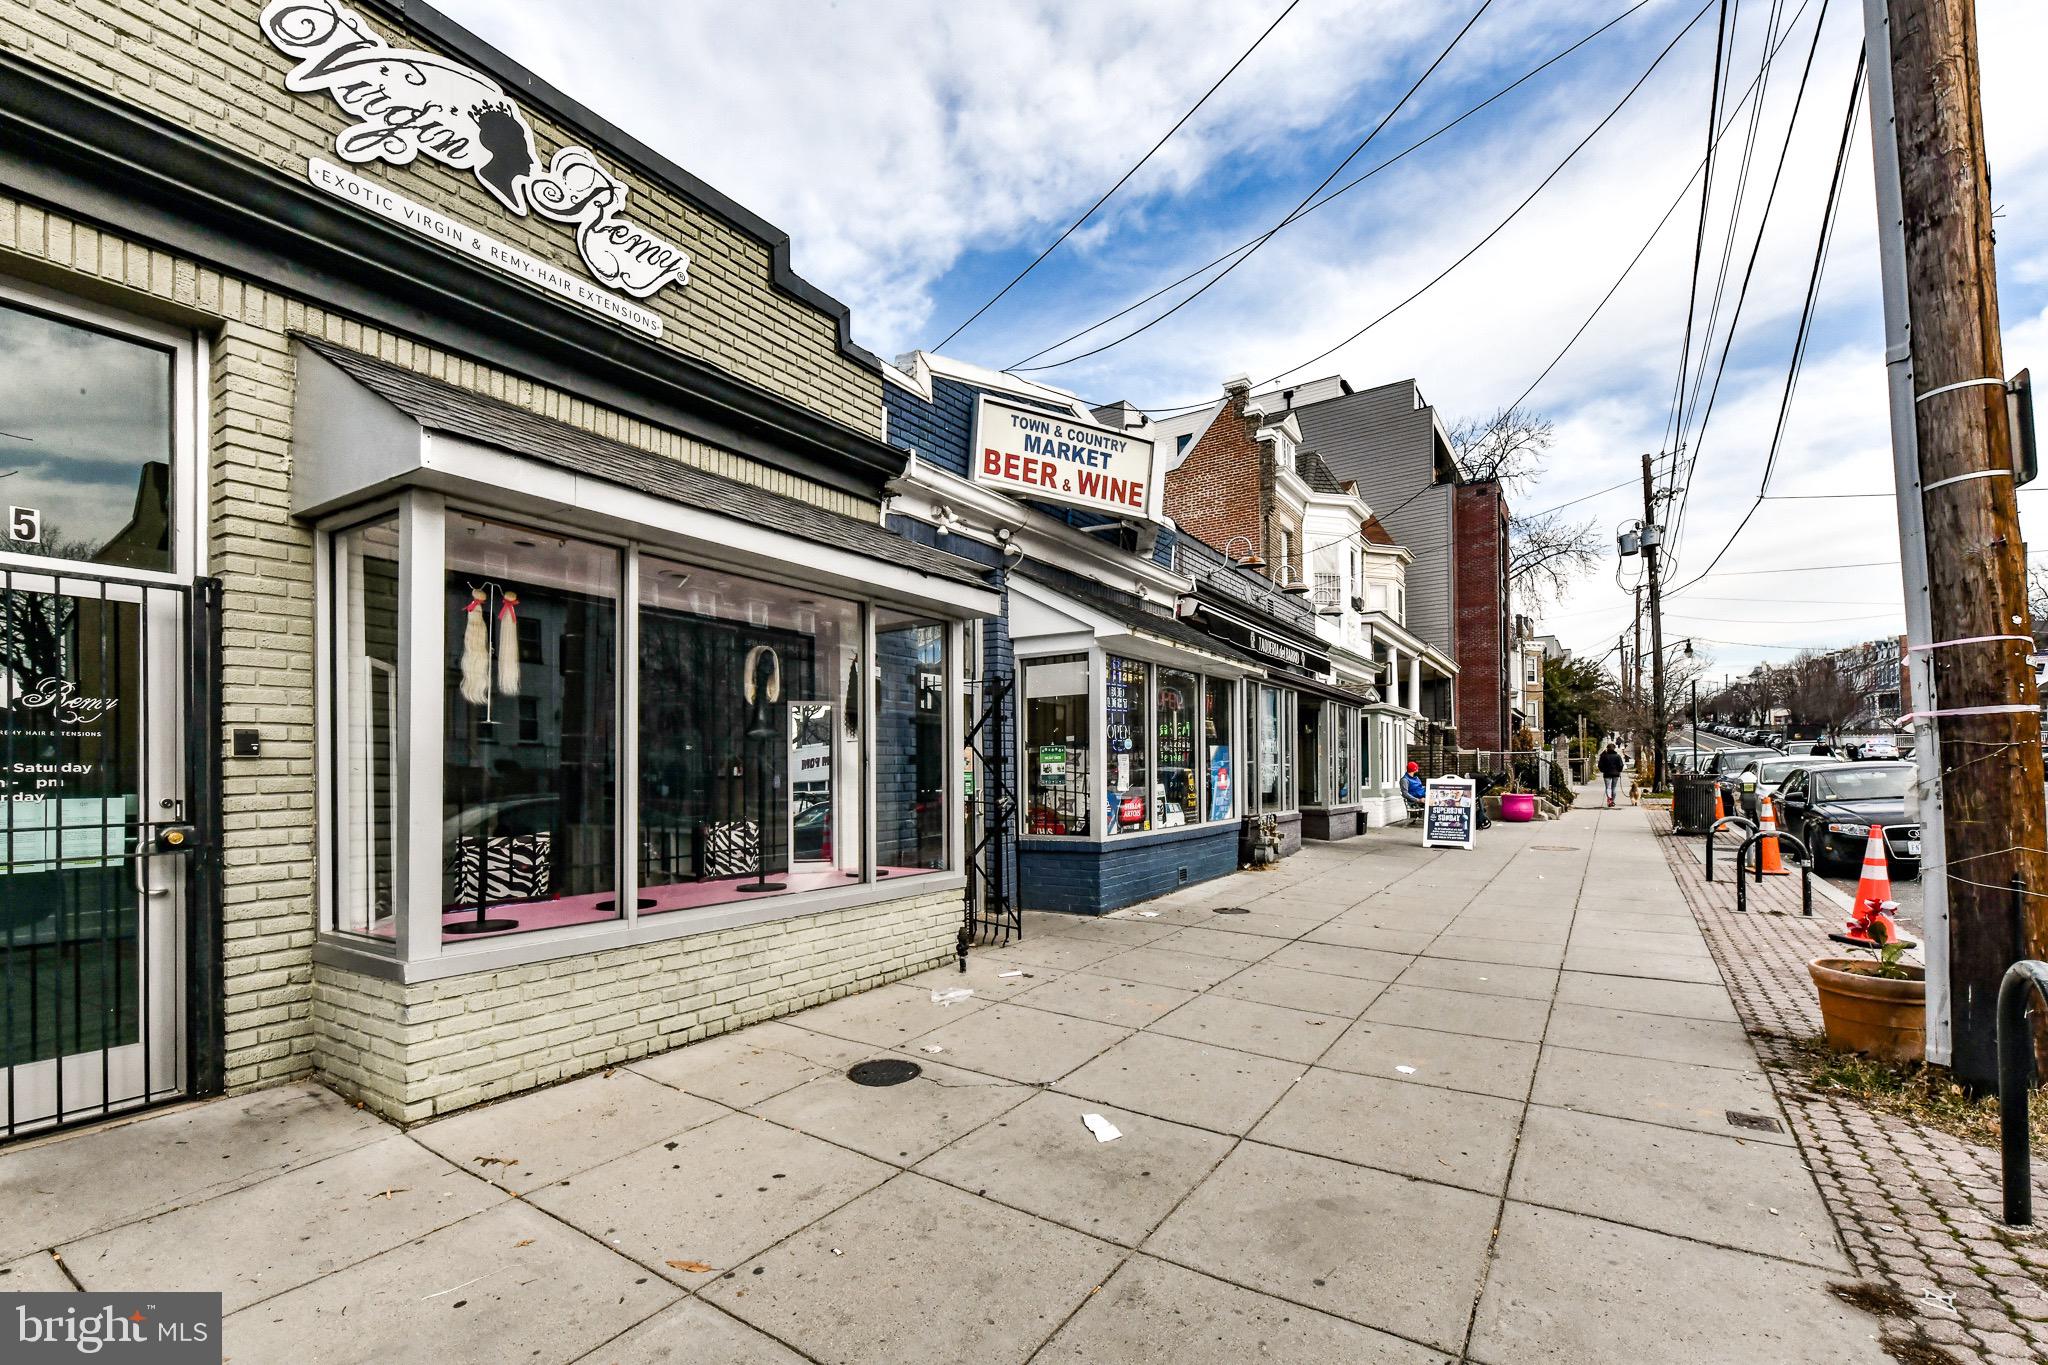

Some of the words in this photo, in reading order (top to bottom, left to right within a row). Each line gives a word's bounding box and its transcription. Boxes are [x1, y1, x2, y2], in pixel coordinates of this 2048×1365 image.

[270, 0, 503, 160] Virgin
[533, 150, 688, 290] Remy
[322, 169, 393, 211] EXOTIC
[403, 206, 463, 242] VIRGIN
[471, 238, 482, 250] &
[491, 246, 530, 271] REMY
[538, 268, 571, 291] HAIR
[578, 286, 658, 331] EXTENSIONS
[1011, 414, 1050, 435] TOWN
[1054, 425, 1063, 438] &
[1067, 428, 1127, 453] COUNTRY
[1024, 434, 1112, 469] MARKET
[984, 448, 1057, 489] BEER
[1062, 478, 1072, 492] &
[1078, 469, 1144, 507] WINE
[13, 508, 36, 541] 5
[22, 676, 119, 724] Remy
